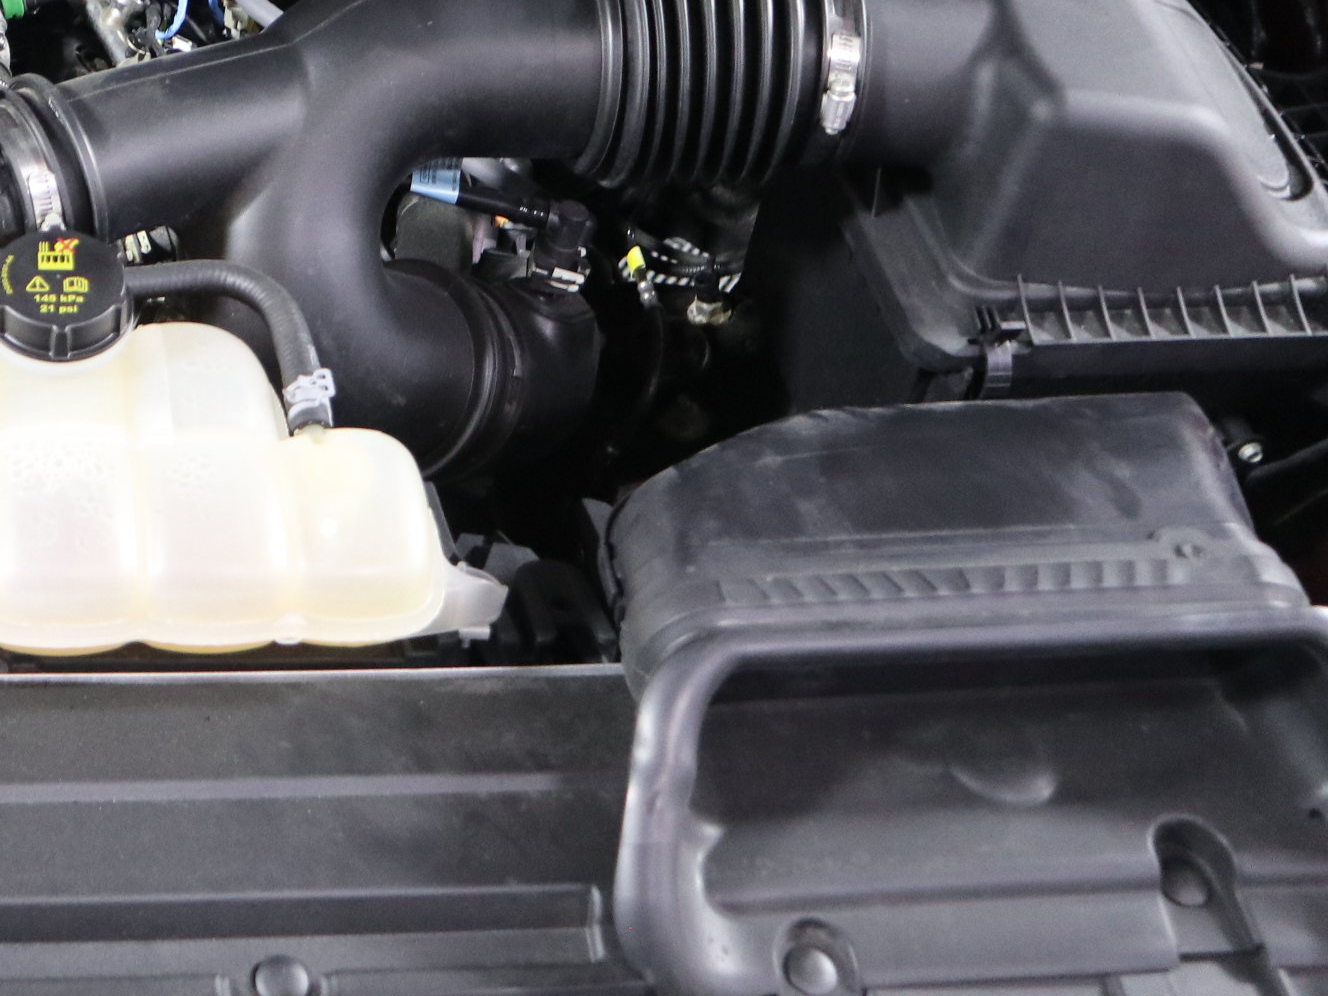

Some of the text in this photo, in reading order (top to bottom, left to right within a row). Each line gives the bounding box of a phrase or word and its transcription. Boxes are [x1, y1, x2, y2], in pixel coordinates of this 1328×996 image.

[60, 294, 84, 303] kPa
[39, 304, 78, 314] 21 psi
